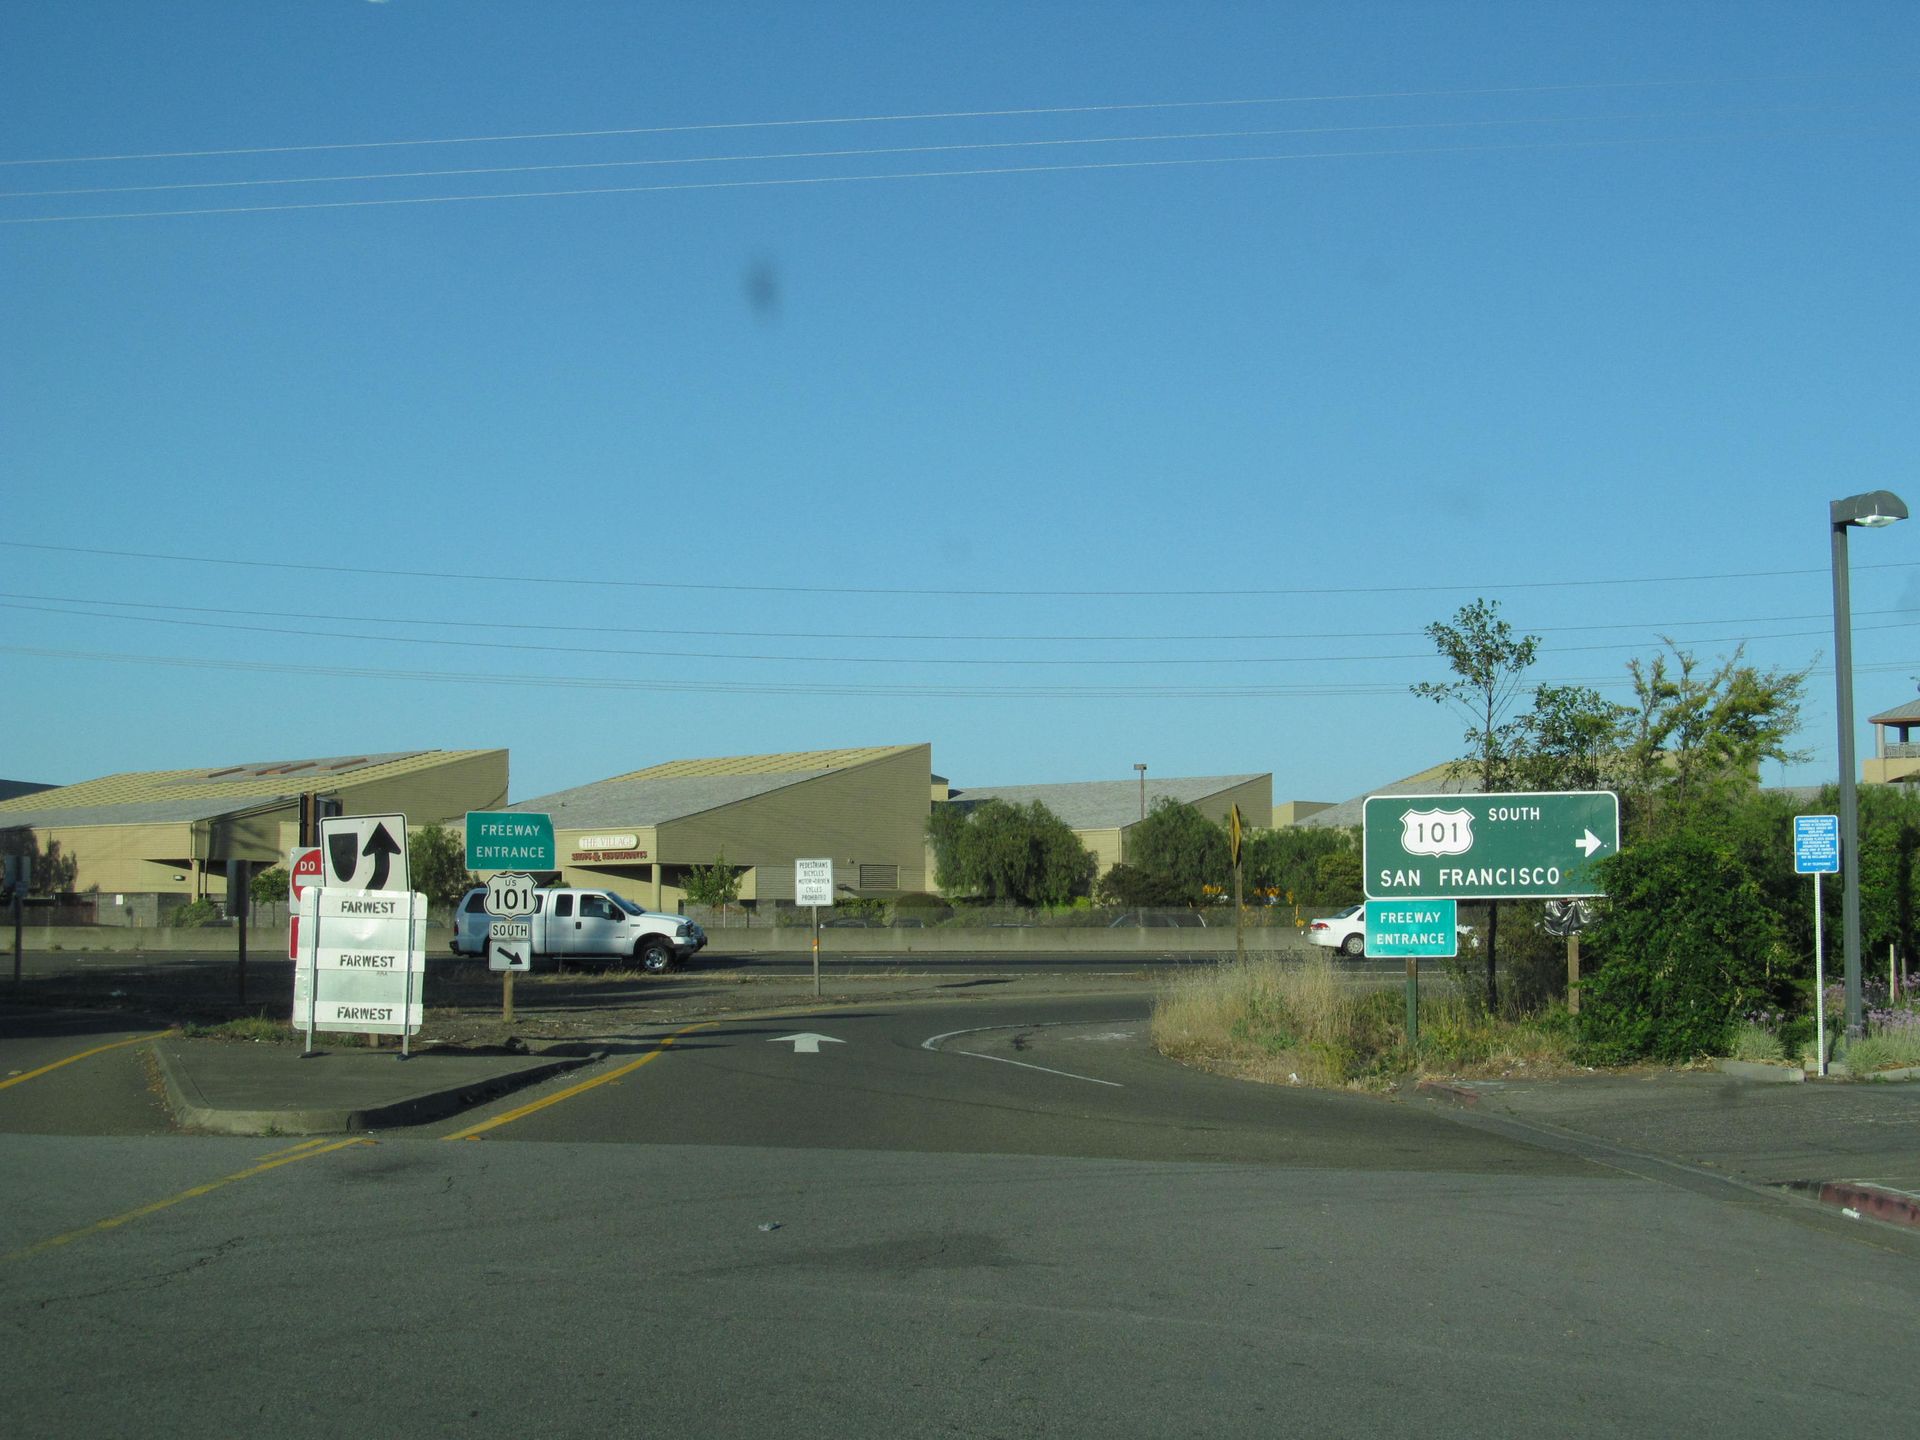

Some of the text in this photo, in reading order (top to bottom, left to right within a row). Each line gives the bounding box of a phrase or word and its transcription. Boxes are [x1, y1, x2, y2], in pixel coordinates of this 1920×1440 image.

[1488, 807, 1540, 821] SOUTH
[481, 824, 540, 836] FREEWAY
[1417, 822, 1458, 843] 101
[582, 836, 633, 848] THE VILLAGE
[476, 846, 545, 858] ENTRANCE
[300, 860, 316, 872] DO
[799, 861, 829, 869] PEDESTRIANS
[505, 879, 517, 887] US
[1380, 867, 1560, 887] SAN FRANCISCO
[494, 888, 528, 910] 101
[340, 900, 396, 914] FARWEST
[1380, 911, 1442, 924] FREEWAY
[492, 924, 528, 936] SOUTH
[1376, 932, 1445, 945] ENTRANCE
[339, 953, 396, 968] FARWEST
[337, 1006, 393, 1021] FARWEST
